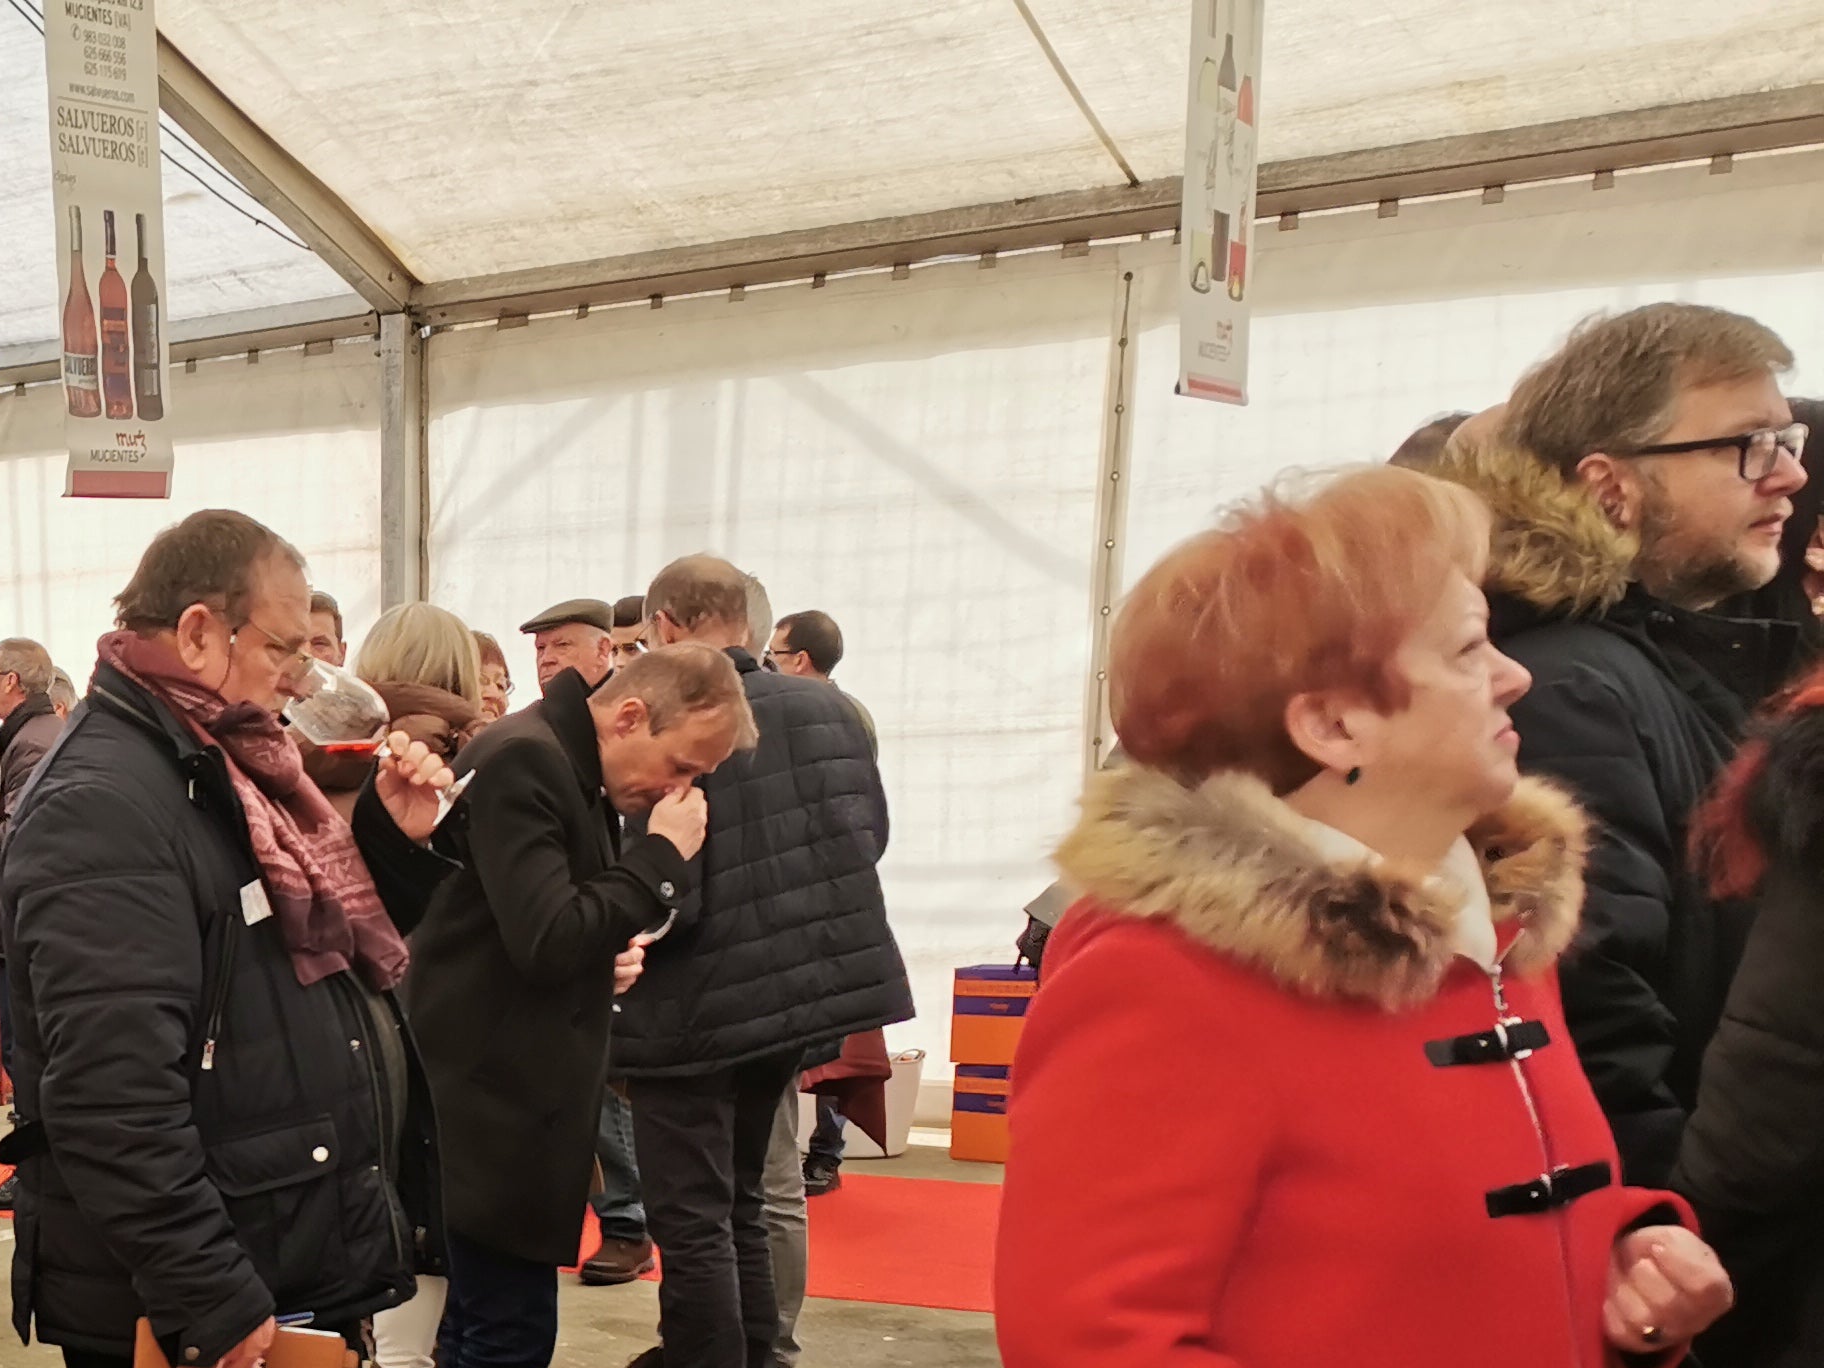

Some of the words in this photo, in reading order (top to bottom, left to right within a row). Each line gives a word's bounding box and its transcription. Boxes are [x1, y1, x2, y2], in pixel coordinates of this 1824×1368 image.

[65, 2, 113, 25] MUCIENTES
[57, 106, 135, 137] SALVUEROS
[58, 132, 136, 163] SALVUEROS
[90, 449, 139, 463] MUCIENTES
